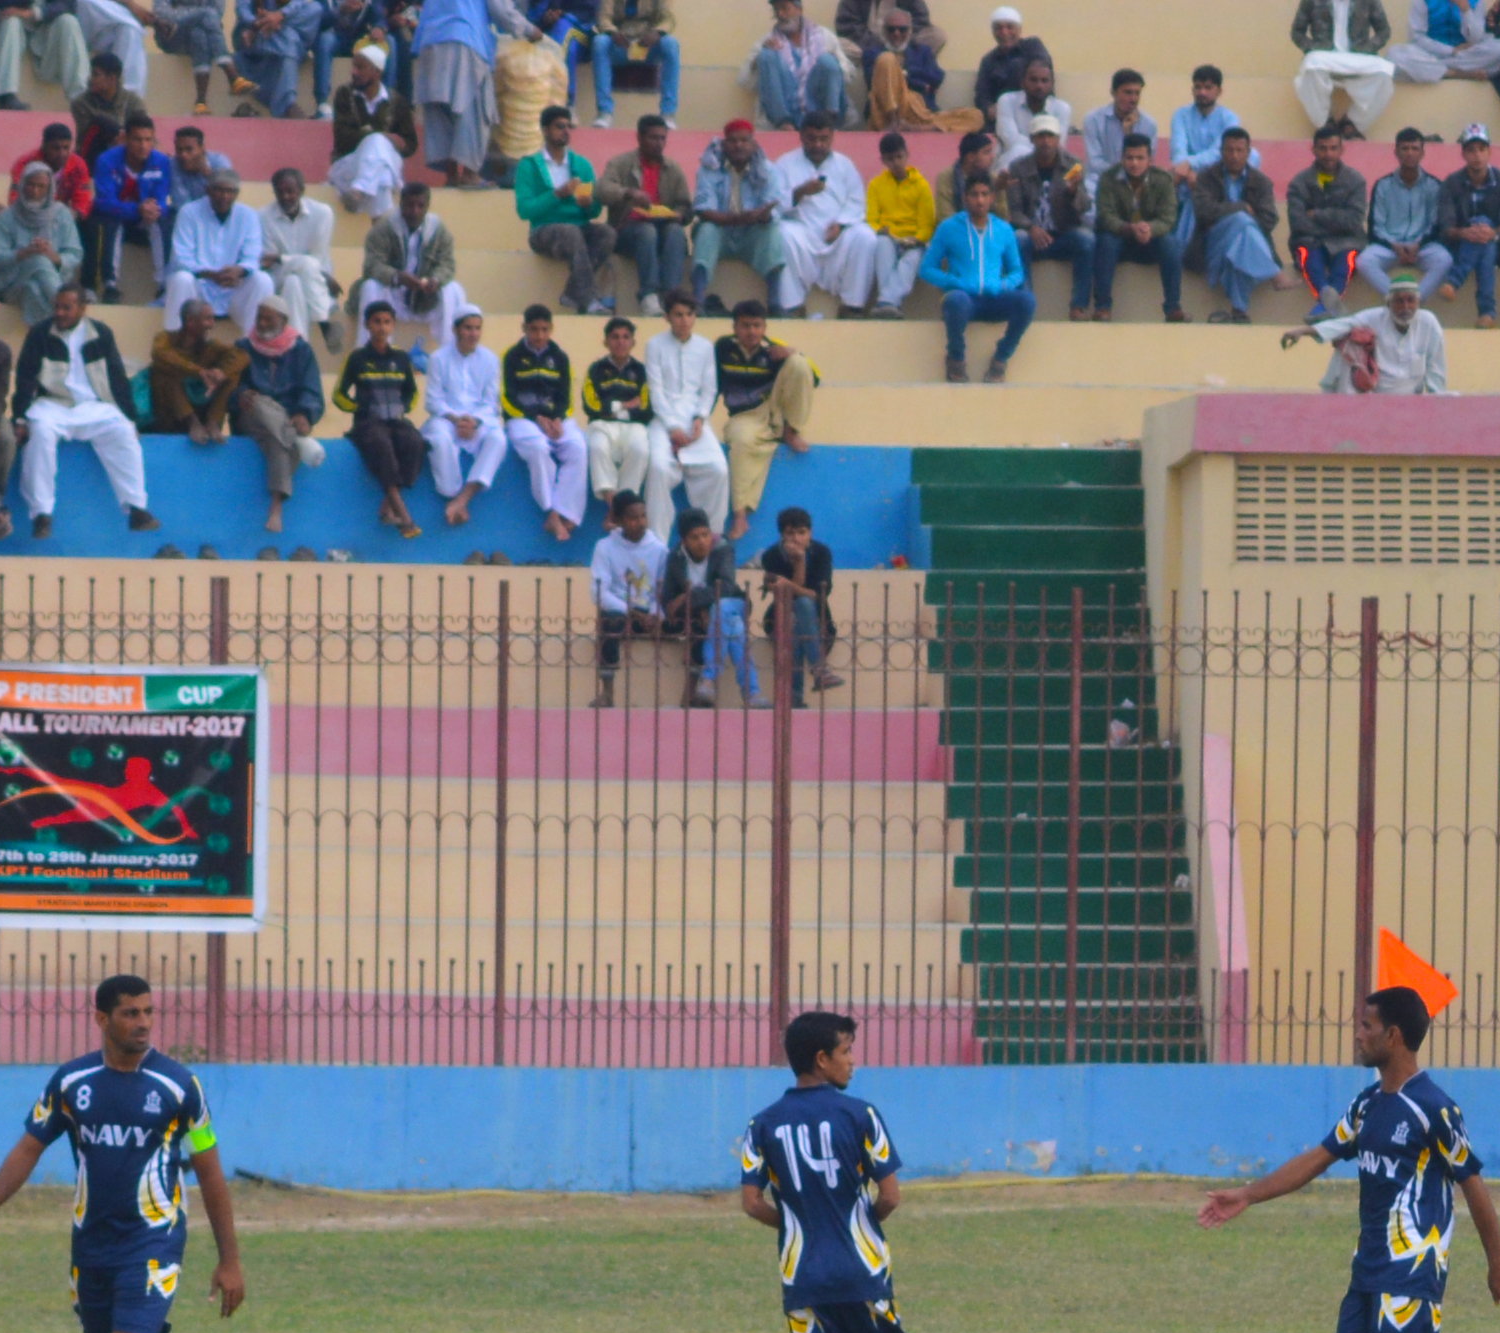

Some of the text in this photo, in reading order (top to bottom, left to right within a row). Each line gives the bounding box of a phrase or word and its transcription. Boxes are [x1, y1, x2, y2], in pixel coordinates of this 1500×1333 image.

[14, 681, 135, 706] PRESIDENT
[177, 685, 223, 705] CUP
[43, 713, 246, 738] TOURNAMENT-2017
[26, 850, 45, 862] to
[48, 851, 87, 863] 29th
[33, 866, 108, 878] Football
[113, 868, 190, 880] Stadium
[76, 1084, 92, 1110] 8
[80, 1124, 156, 1147] NAVY
[775, 1120, 841, 1192] 14
